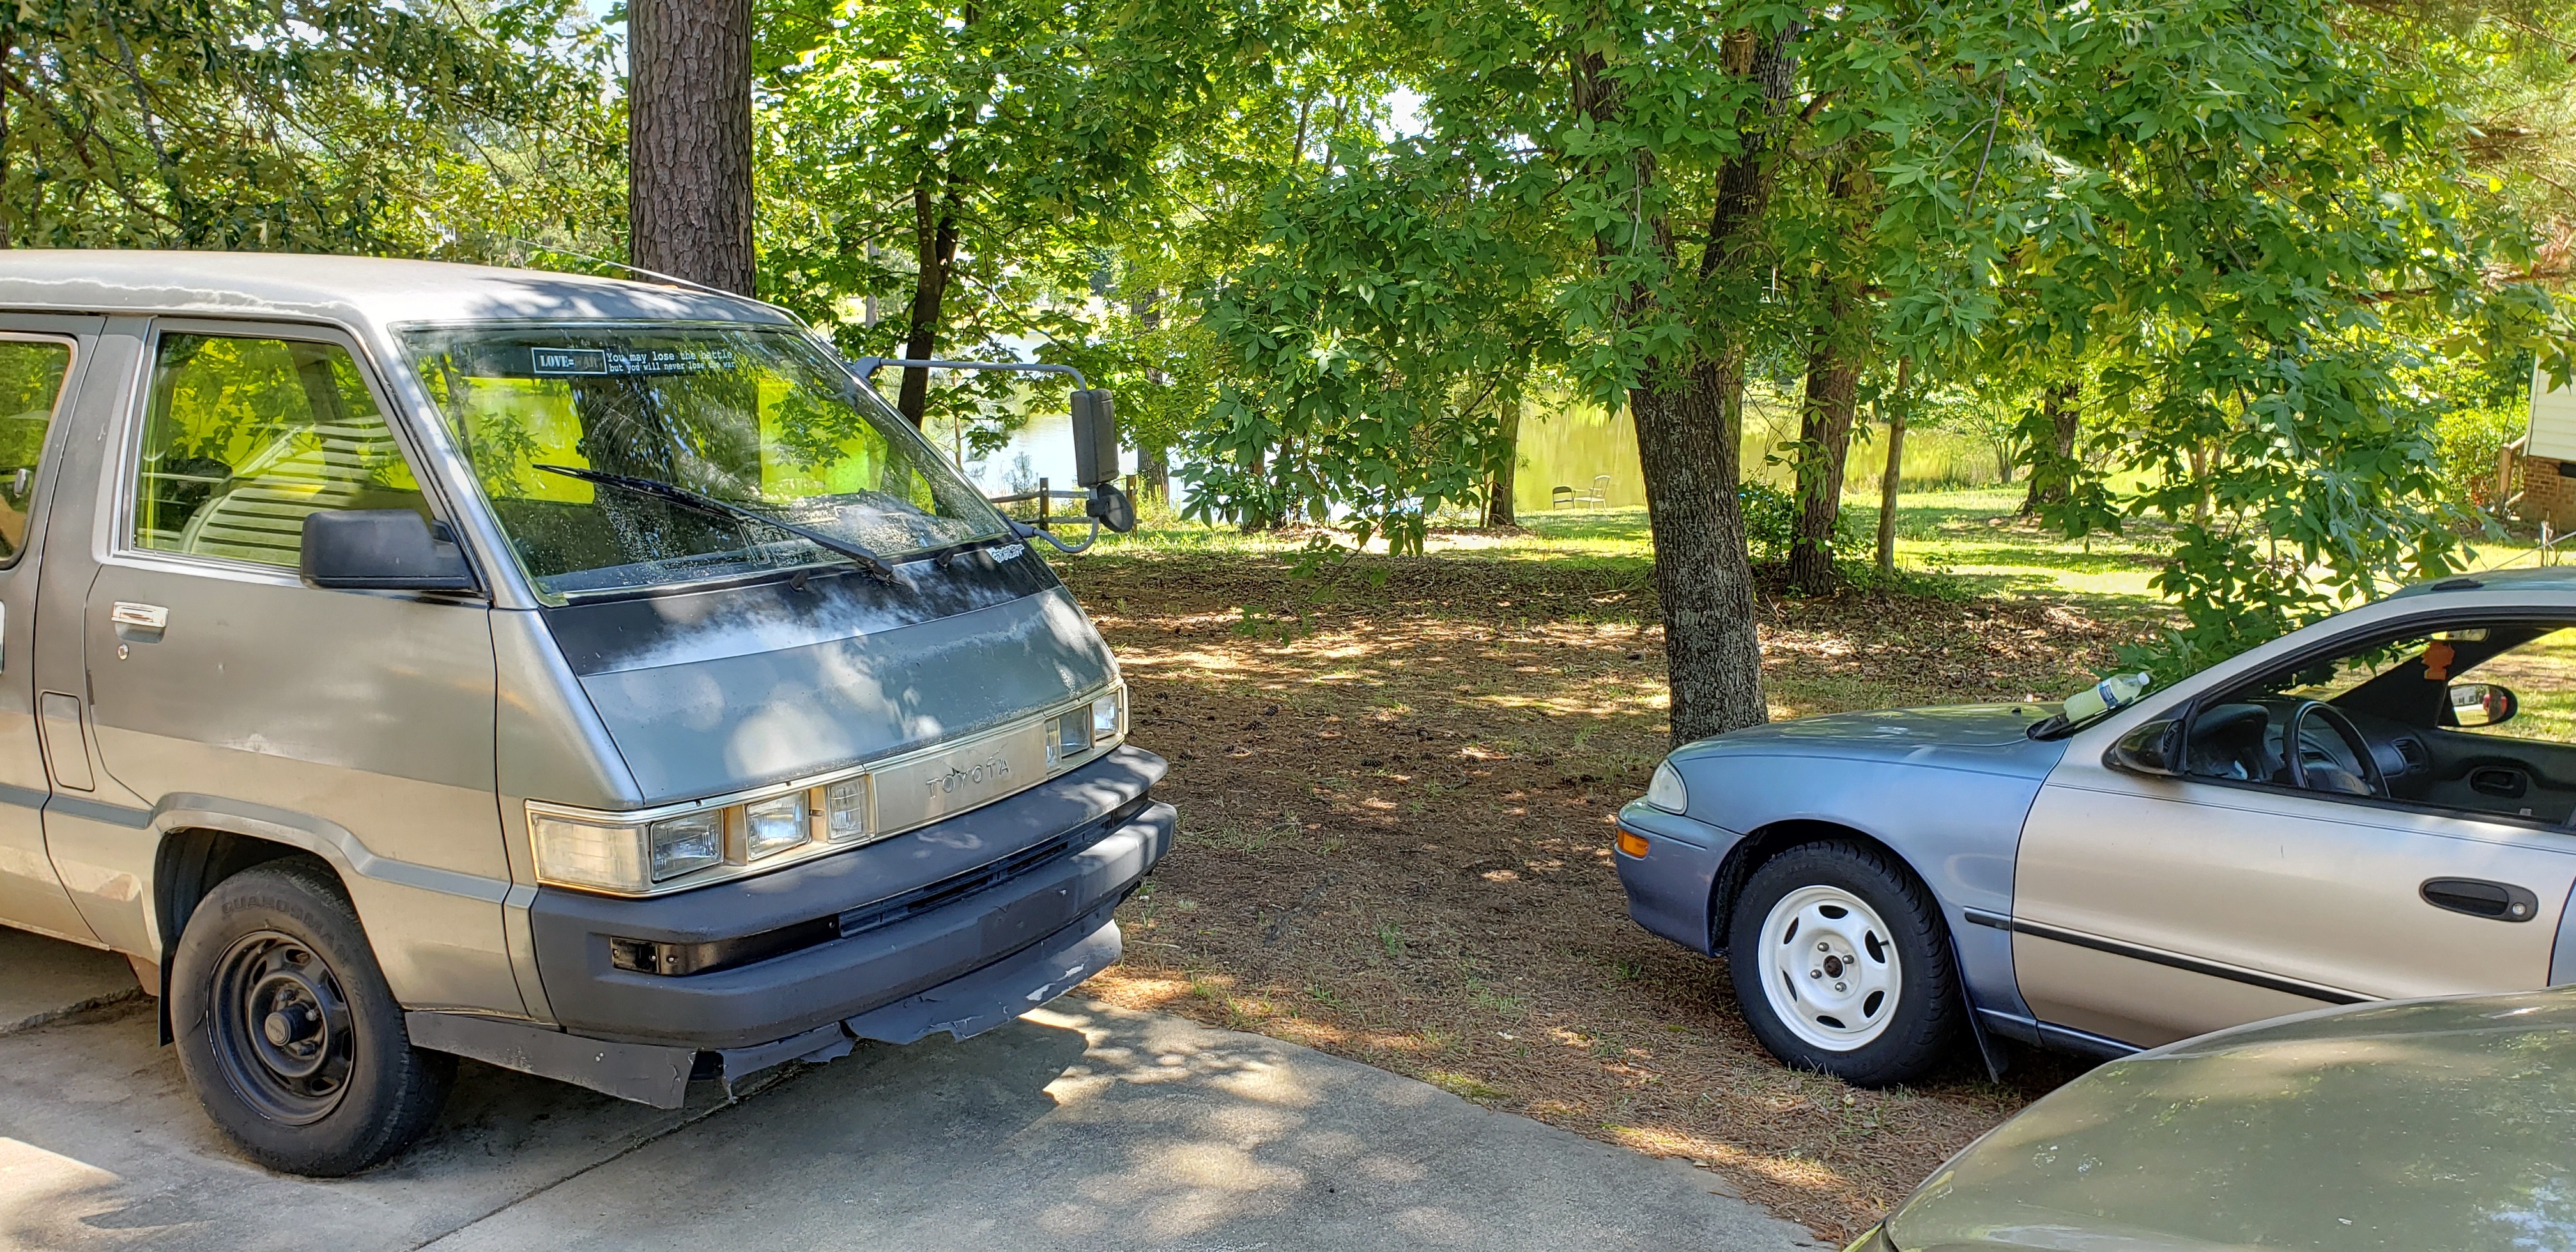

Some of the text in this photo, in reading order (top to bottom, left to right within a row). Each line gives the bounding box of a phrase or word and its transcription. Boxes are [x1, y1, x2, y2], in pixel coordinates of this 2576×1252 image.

[606, 353, 625, 362] You
[629, 353, 647, 364] may
[652, 351, 675, 361] lose
[680, 351, 696, 360] the
[610, 363, 624, 372] but
[627, 363, 641, 374] you
[643, 362, 661, 370] will
[664, 362, 685, 370] never
[688, 361, 705, 369] lose
[709, 360, 721, 369] the
[925, 757, 1011, 800] TOYOTA
